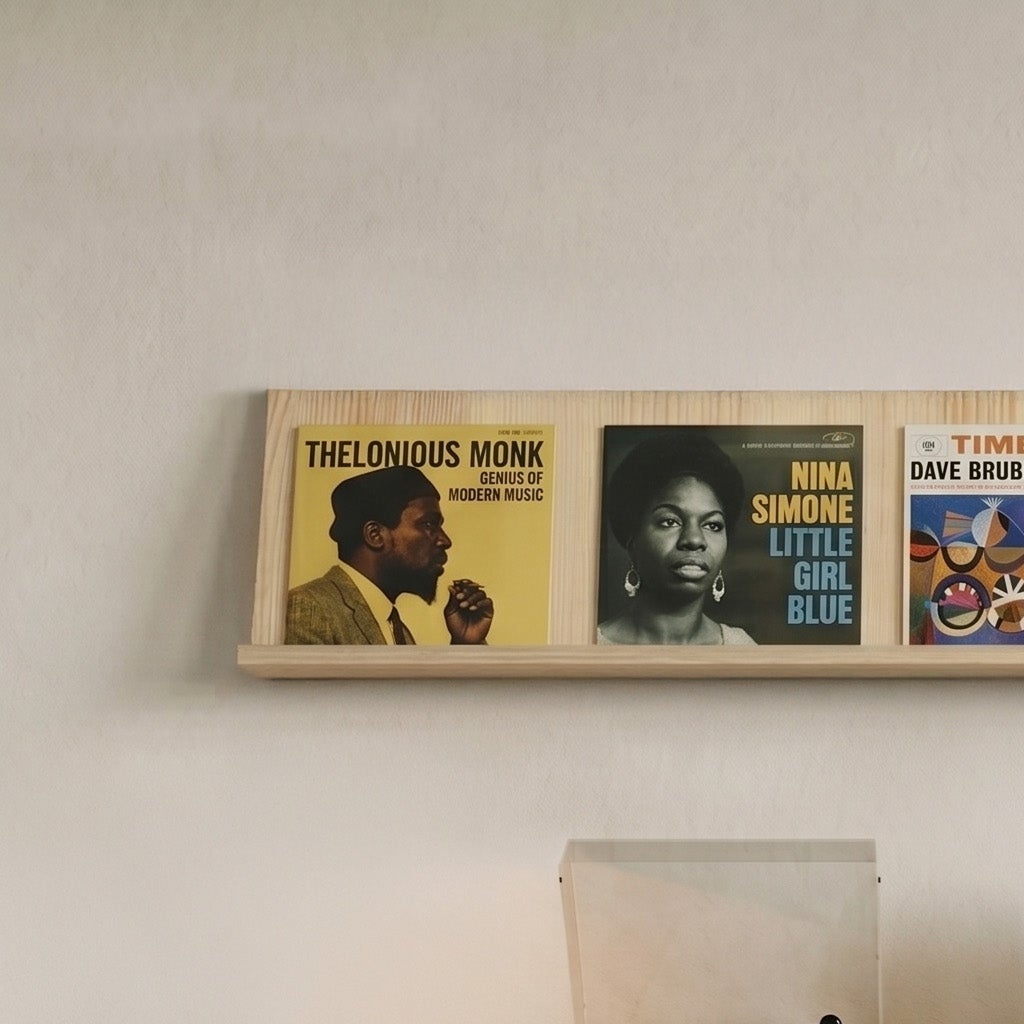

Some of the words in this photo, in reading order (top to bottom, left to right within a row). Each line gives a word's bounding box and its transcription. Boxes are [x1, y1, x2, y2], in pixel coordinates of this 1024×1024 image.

[305, 440, 460, 468] THELONIOUS
[469, 440, 544, 468] MONK
[479, 471, 524, 485] GENIUS
[527, 471, 544, 485] OF
[791, 461, 854, 490] NINA
[910, 461, 961, 480] DAVE
[448, 488, 500, 502] MODERN
[504, 488, 544, 502] MUSIC
[751, 494, 853, 524] SIMONE
[769, 527, 853, 557] LITTLE
[793, 560, 853, 591] GIRL
[787, 595, 853, 625] BLUE
